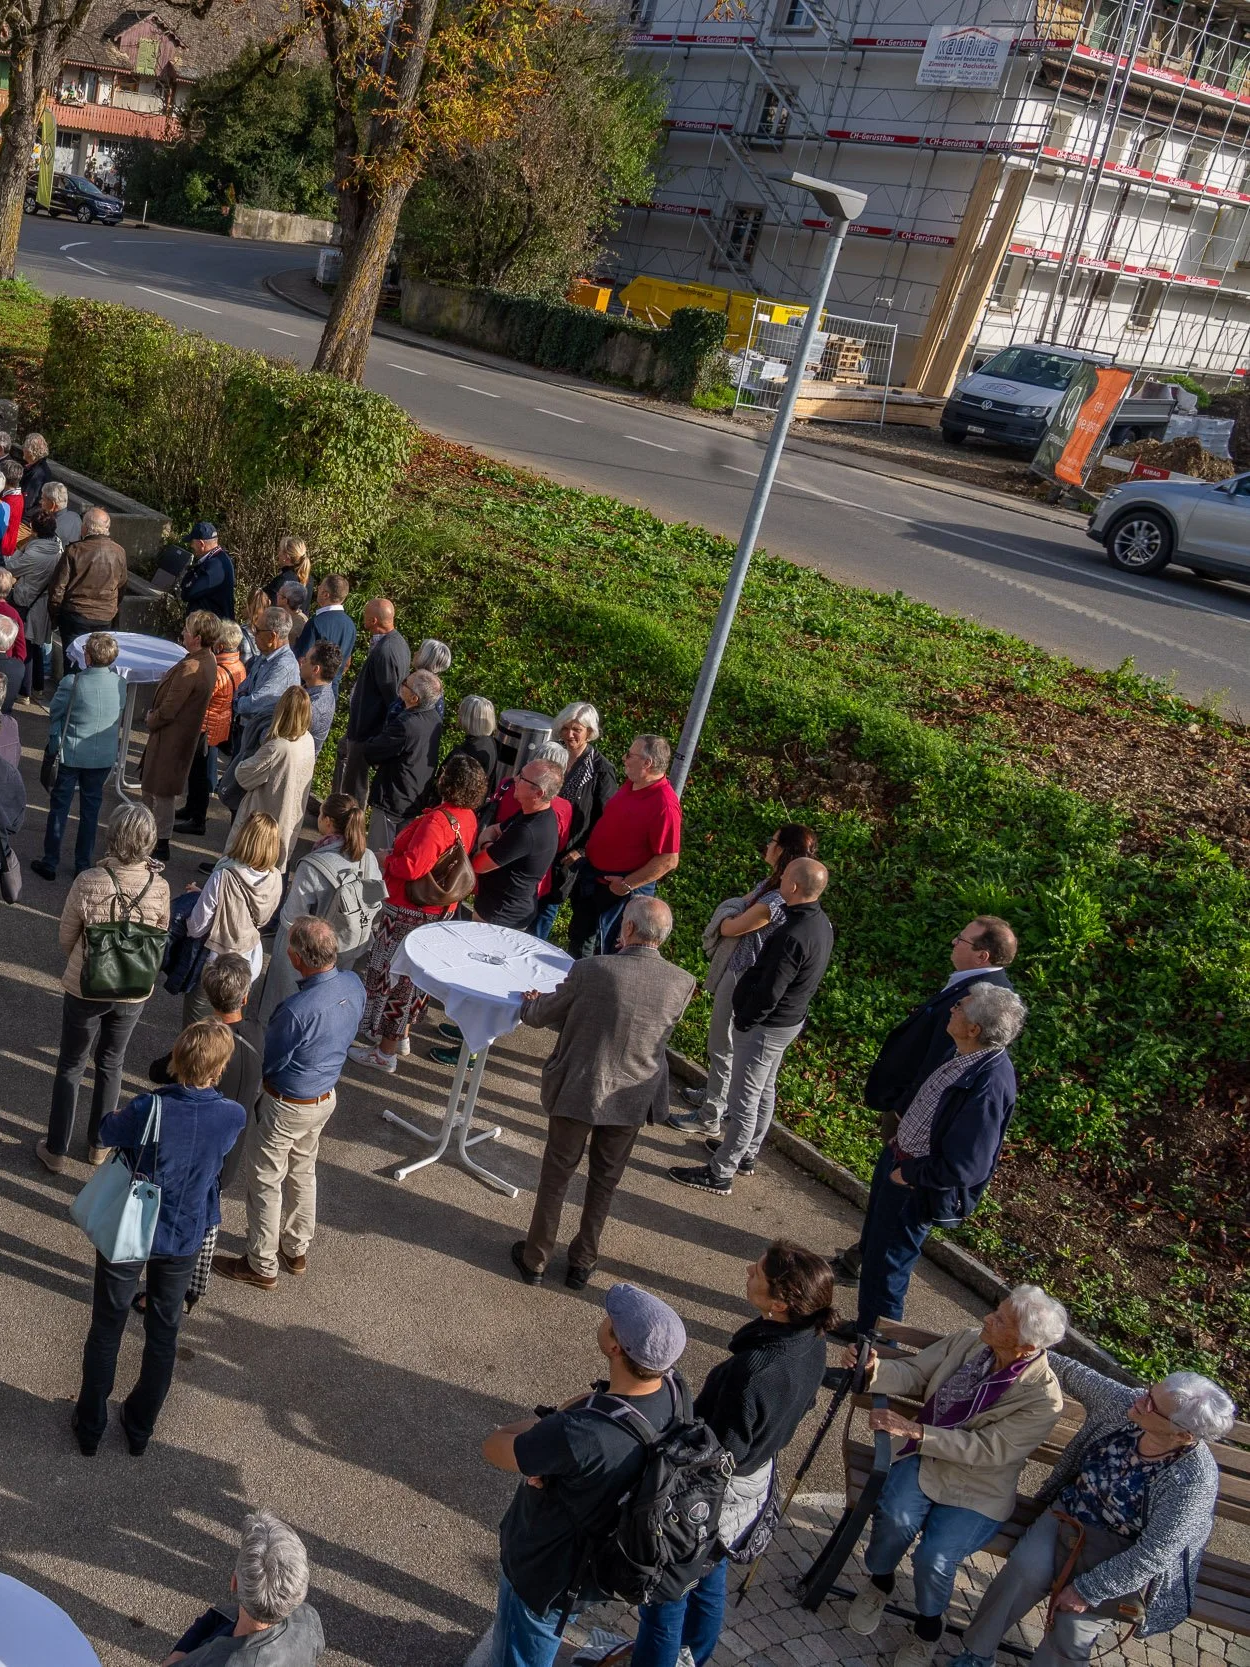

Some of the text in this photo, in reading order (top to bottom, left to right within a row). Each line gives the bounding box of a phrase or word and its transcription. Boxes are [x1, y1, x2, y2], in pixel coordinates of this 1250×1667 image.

[876, 38, 923, 47] CH-Gerüstbau
[849, 132, 895, 142] CH-Gerüstbau
[929, 138, 978, 148] CH-Gerüstbau
[901, 232, 949, 244] CH-Gerüstbau
[1142, 468, 1161, 477] KIBAG
